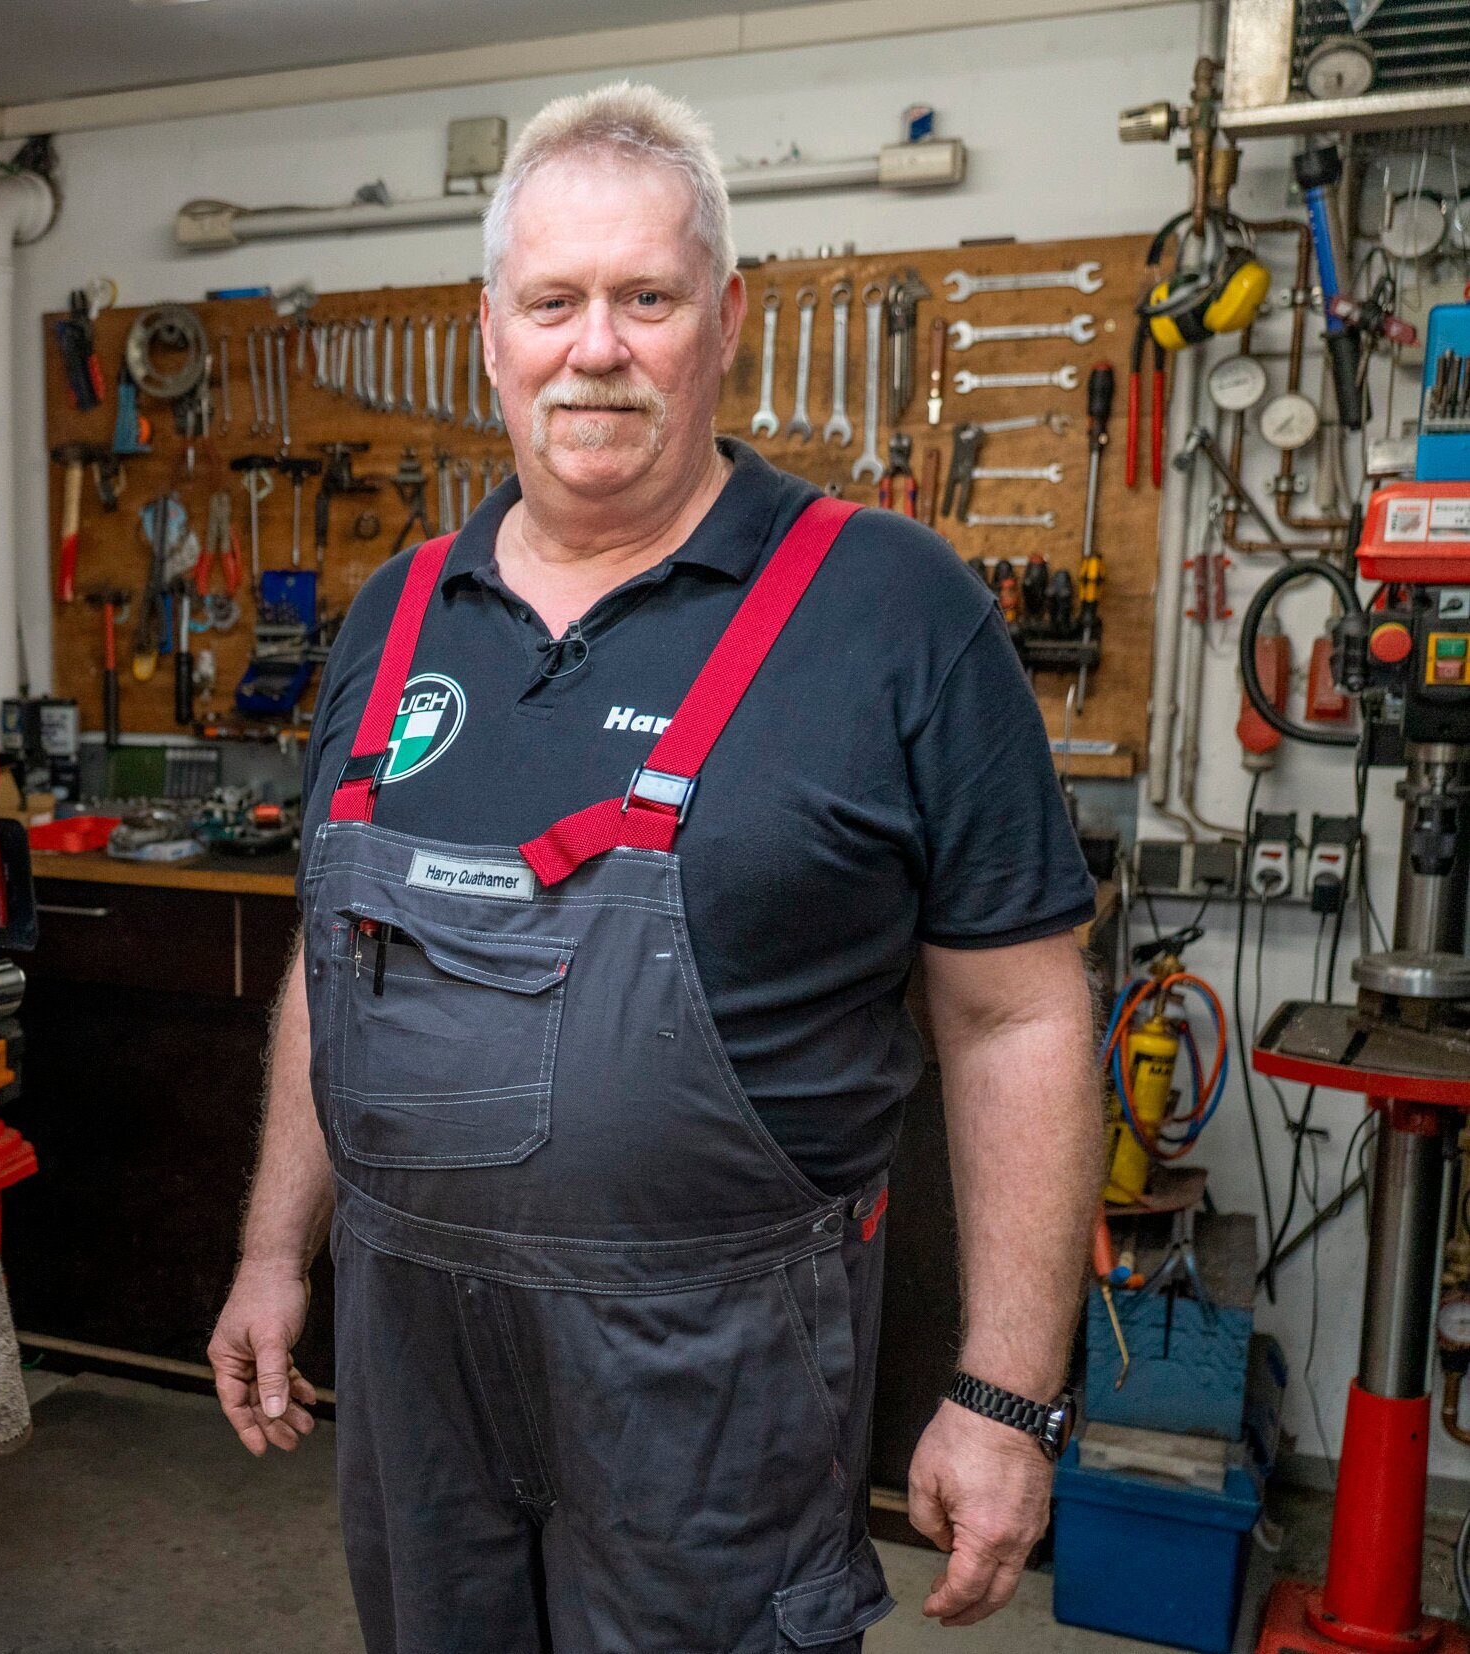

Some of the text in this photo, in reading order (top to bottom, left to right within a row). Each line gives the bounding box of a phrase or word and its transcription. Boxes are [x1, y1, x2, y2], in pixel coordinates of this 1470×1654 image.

[397, 691, 451, 715] UCH
[603, 706, 672, 734] Har
[426, 865, 519, 889] Harry Quathamer
